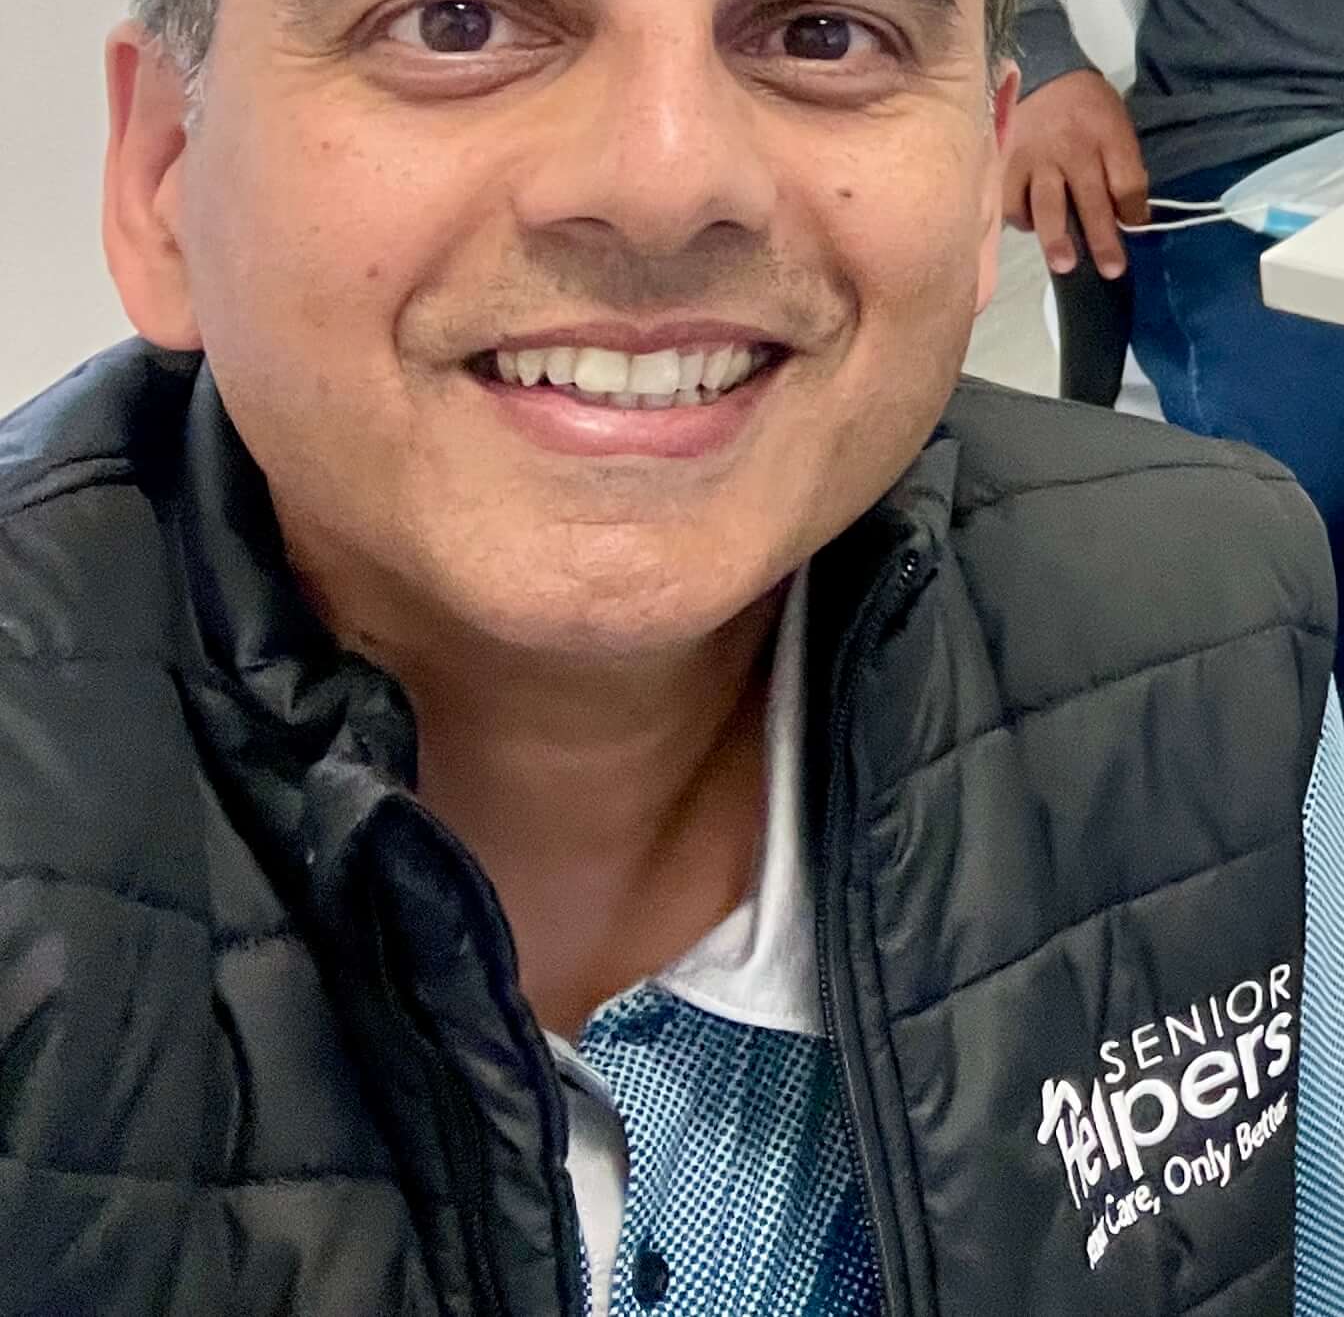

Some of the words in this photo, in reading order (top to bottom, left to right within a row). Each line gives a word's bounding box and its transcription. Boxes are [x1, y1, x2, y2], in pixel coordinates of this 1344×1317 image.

[1100, 963, 1291, 1083] SENIOR
[1046, 1012, 1293, 1210] Helpers
[1164, 1138, 1231, 1195] Only
